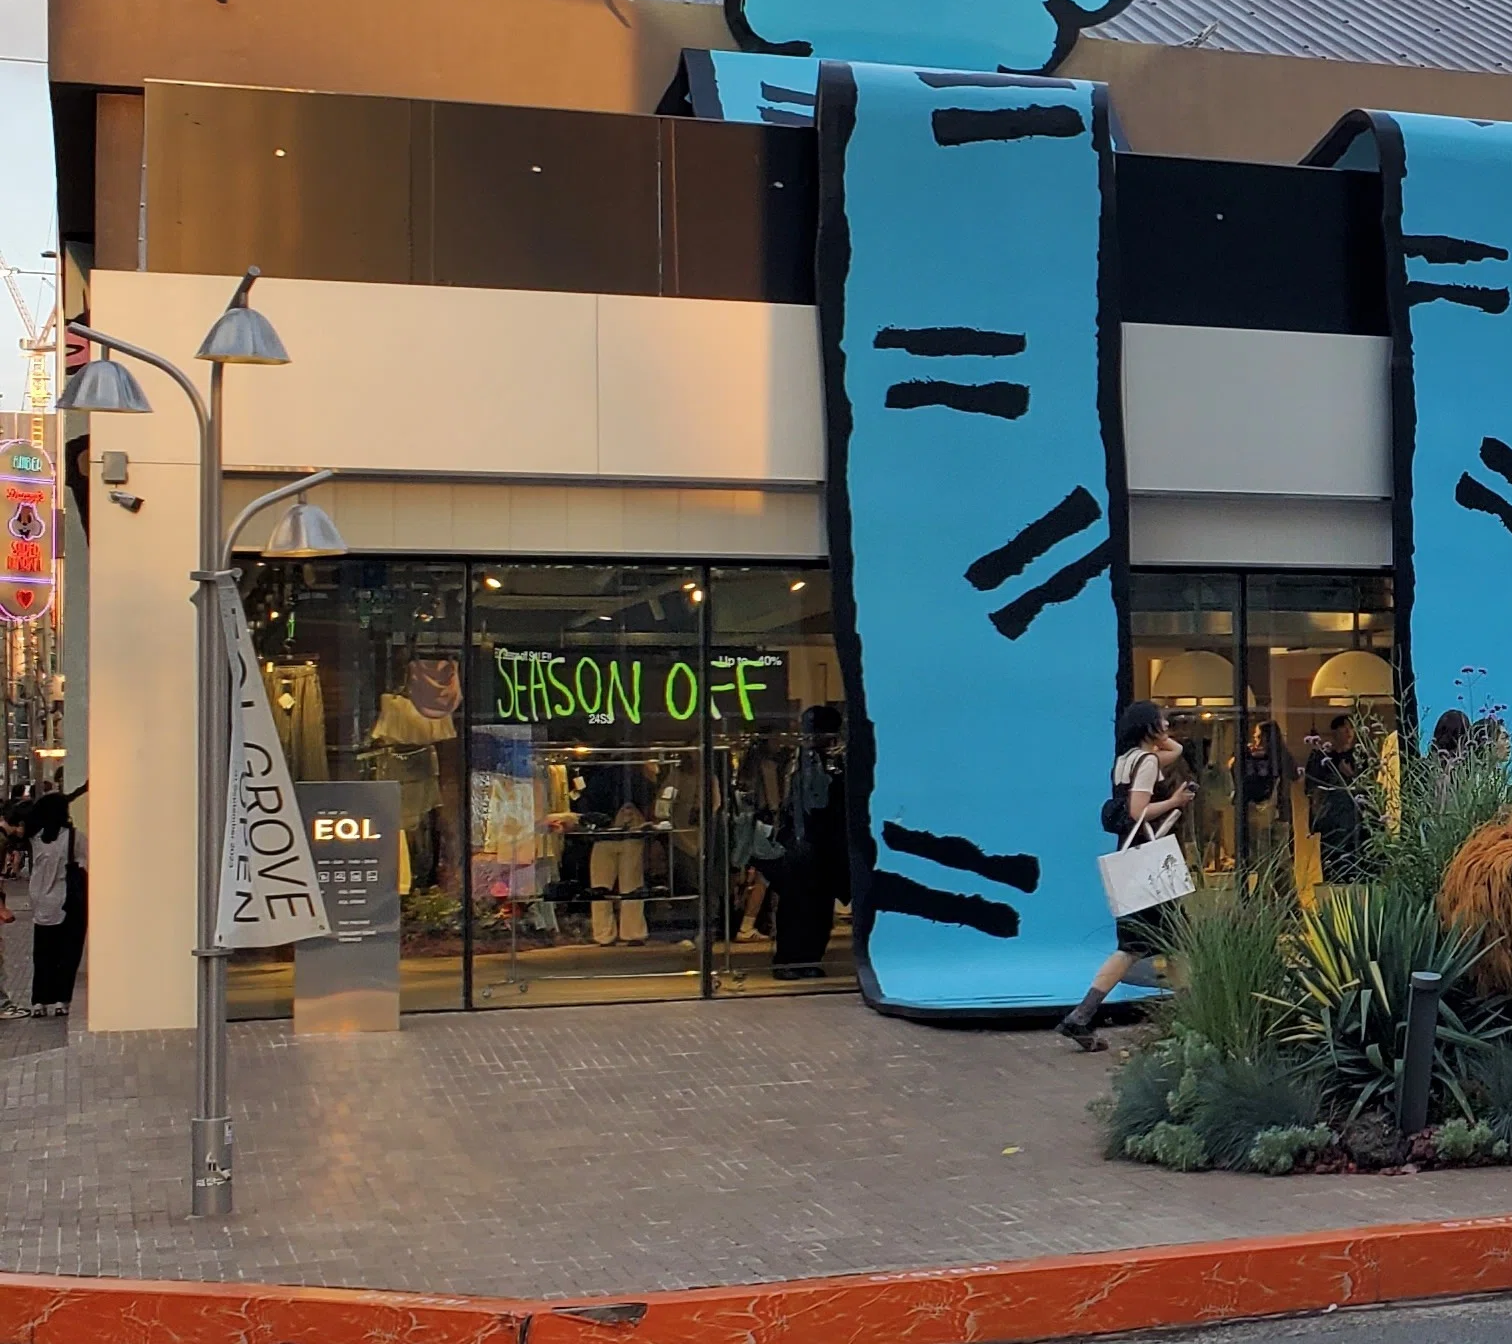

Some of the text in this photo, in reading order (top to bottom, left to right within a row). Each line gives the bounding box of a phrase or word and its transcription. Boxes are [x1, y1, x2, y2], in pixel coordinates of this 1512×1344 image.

[498, 647, 767, 724] SEASON OFF
[243, 741, 317, 921] GROVE
[314, 818, 383, 841] EQL
